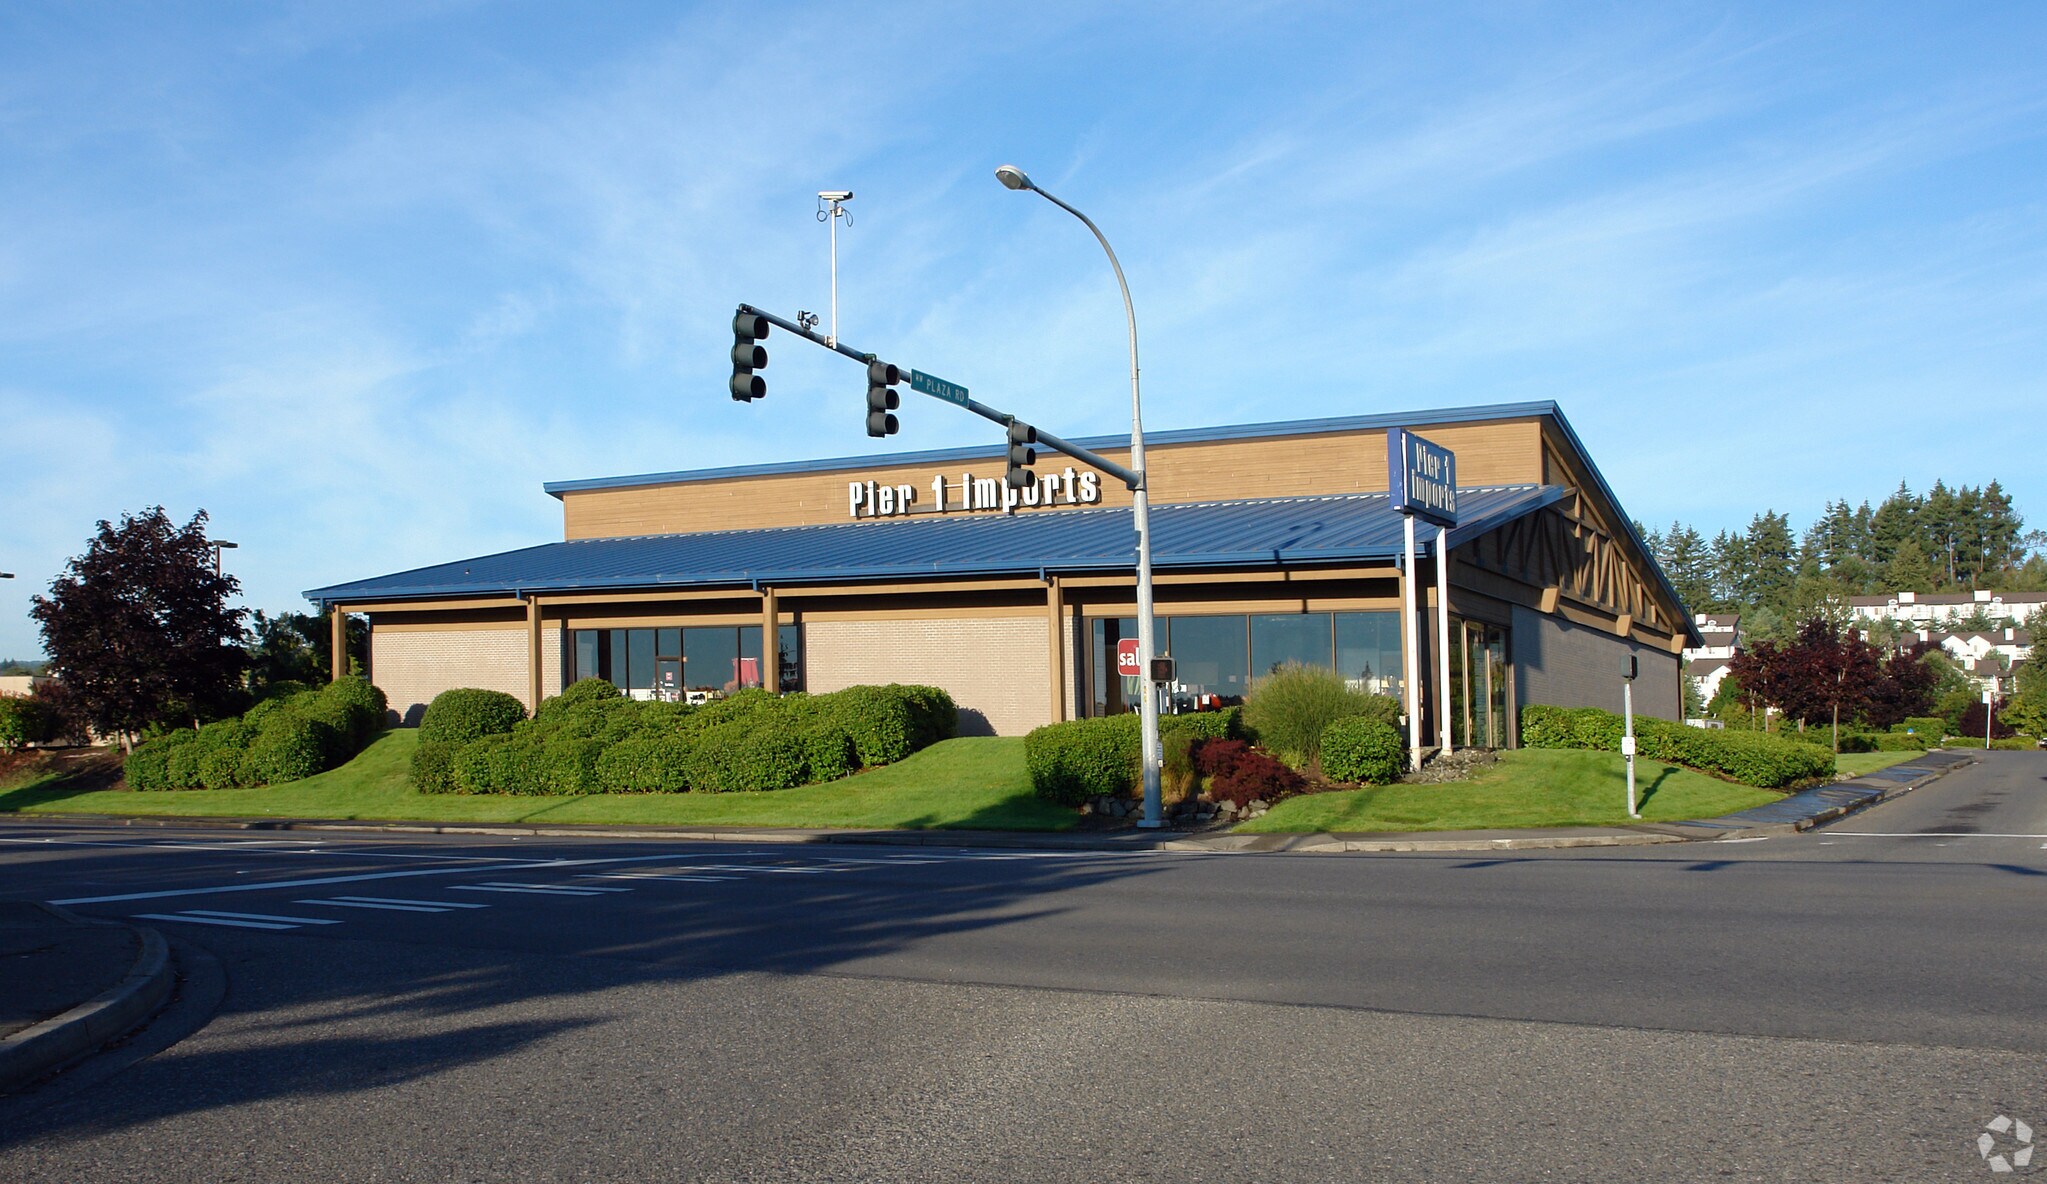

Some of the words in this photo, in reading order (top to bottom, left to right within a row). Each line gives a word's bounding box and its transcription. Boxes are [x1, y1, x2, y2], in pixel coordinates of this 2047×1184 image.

[926, 378, 952, 398] PLAZA
[955, 388, 965, 402] RD
[1416, 442, 1440, 480] Pier
[1444, 455, 1450, 485] 1
[849, 480, 914, 517] Pier
[931, 474, 946, 512] 1
[1411, 468, 1456, 513] imports
[1119, 646, 1141, 666] sal
